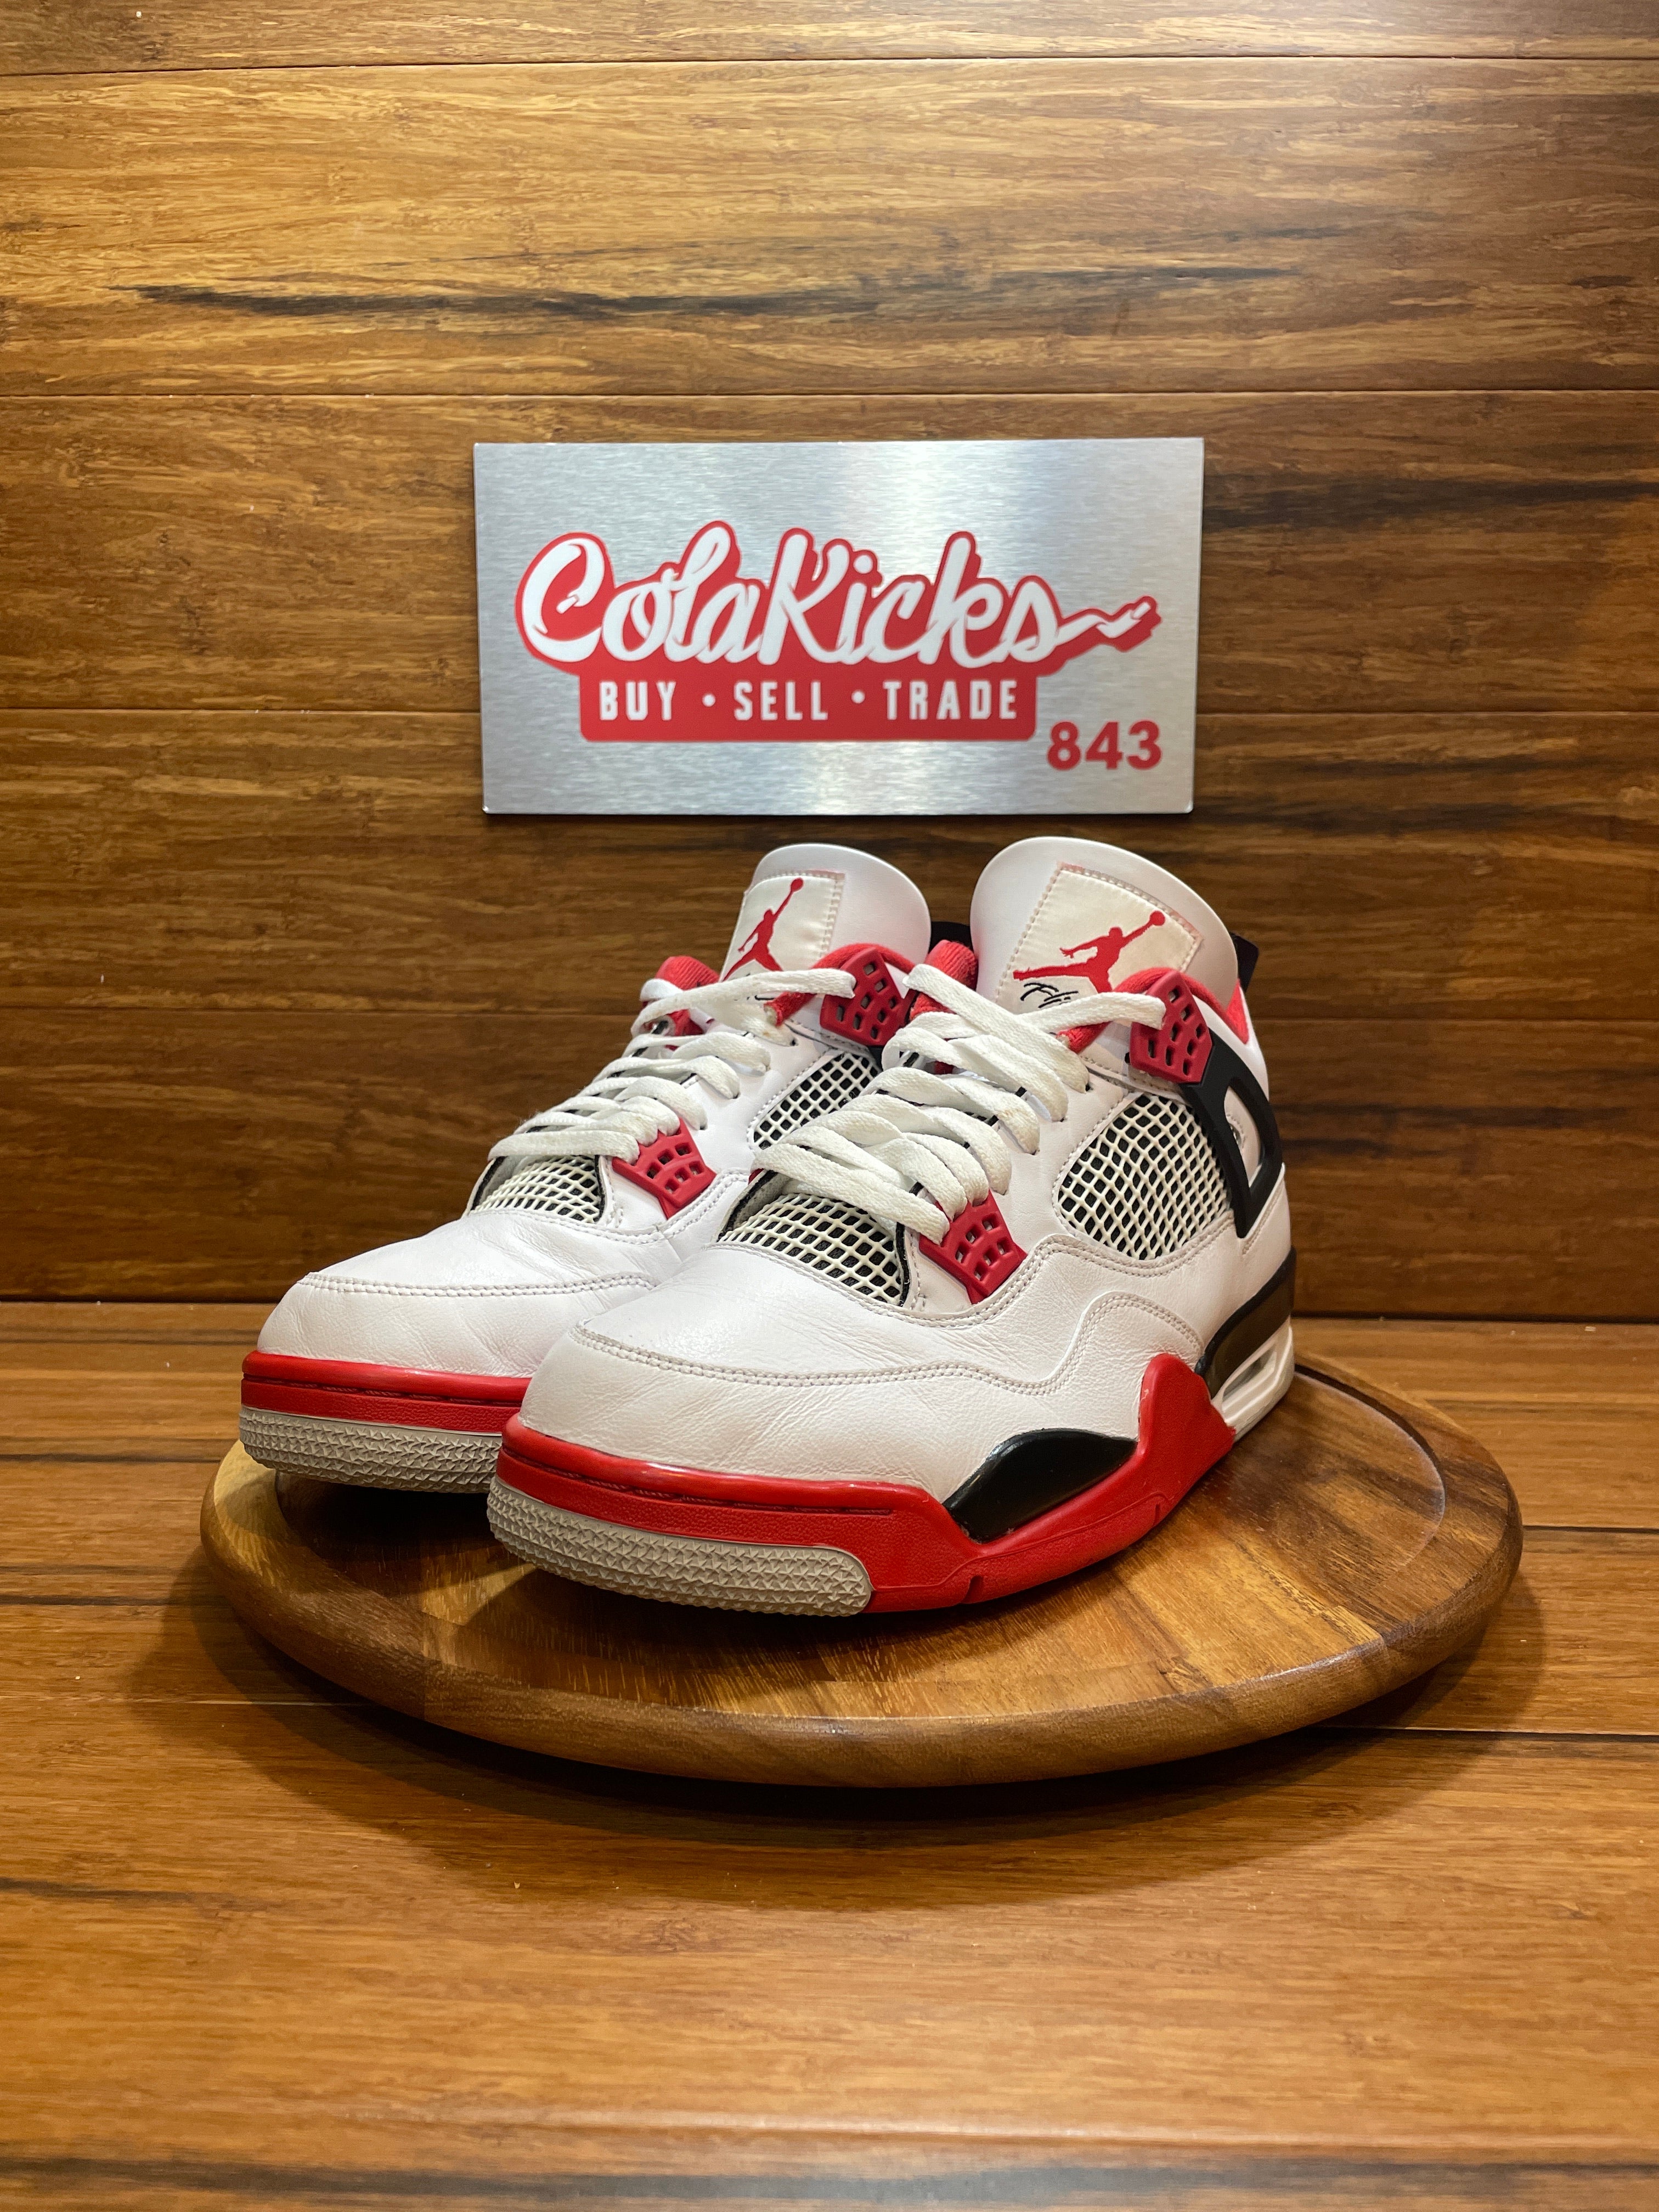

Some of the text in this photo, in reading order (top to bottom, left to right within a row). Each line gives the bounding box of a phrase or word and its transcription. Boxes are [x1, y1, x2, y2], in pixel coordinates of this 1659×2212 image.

[599, 680, 1017, 721] BUY SELL TRADE
[1047, 719, 1162, 770] 843
